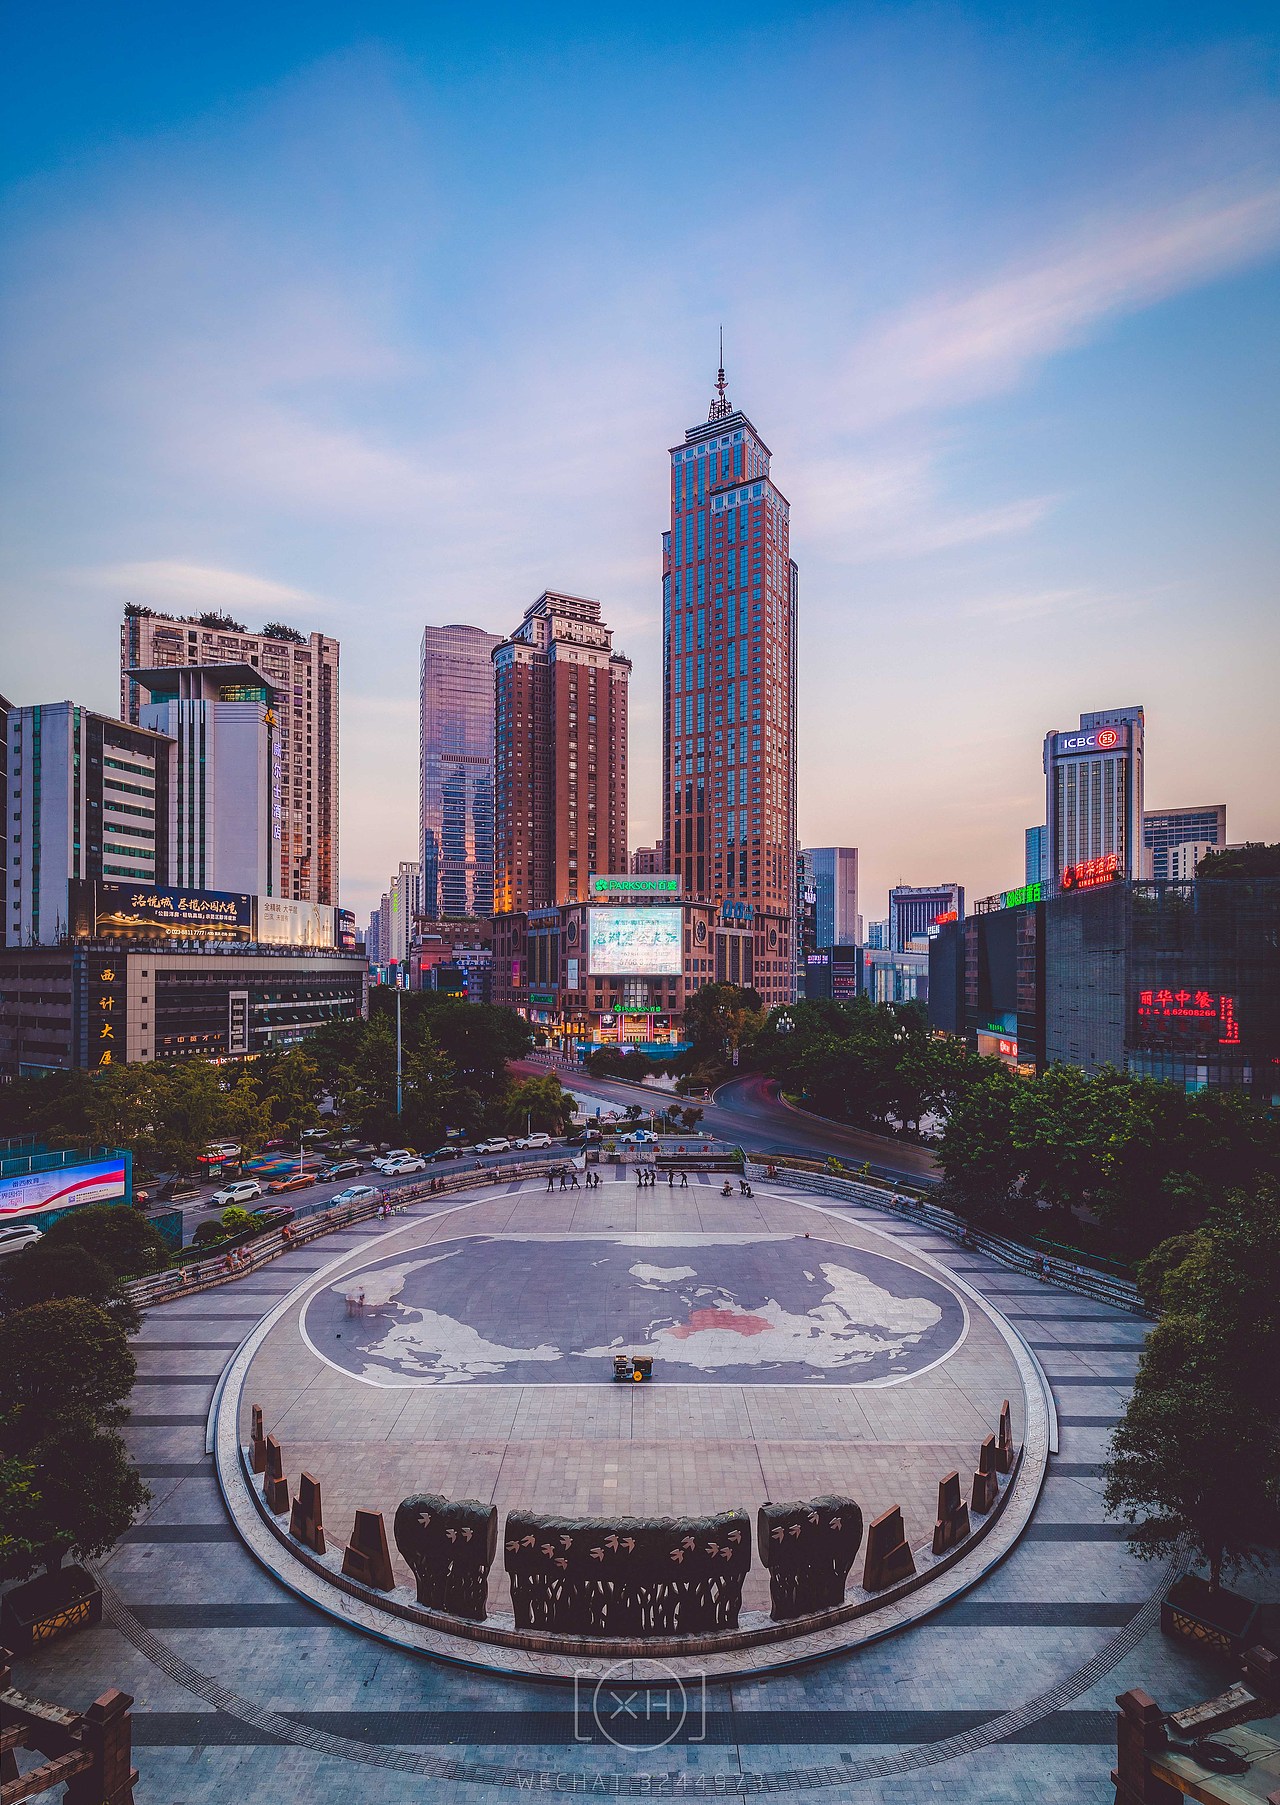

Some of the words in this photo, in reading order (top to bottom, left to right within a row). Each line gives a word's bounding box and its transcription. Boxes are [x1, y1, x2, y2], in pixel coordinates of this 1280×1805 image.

[1064, 736, 1095, 748] ICBC
[1096, 874, 1113, 883] HOTEL
[609, 880, 656, 891] PARKSON
[658, 880, 678, 891] 百盛
[1140, 990, 1215, 1009] 丽华中餐
[99, 969, 115, 1065] 西计大厦
